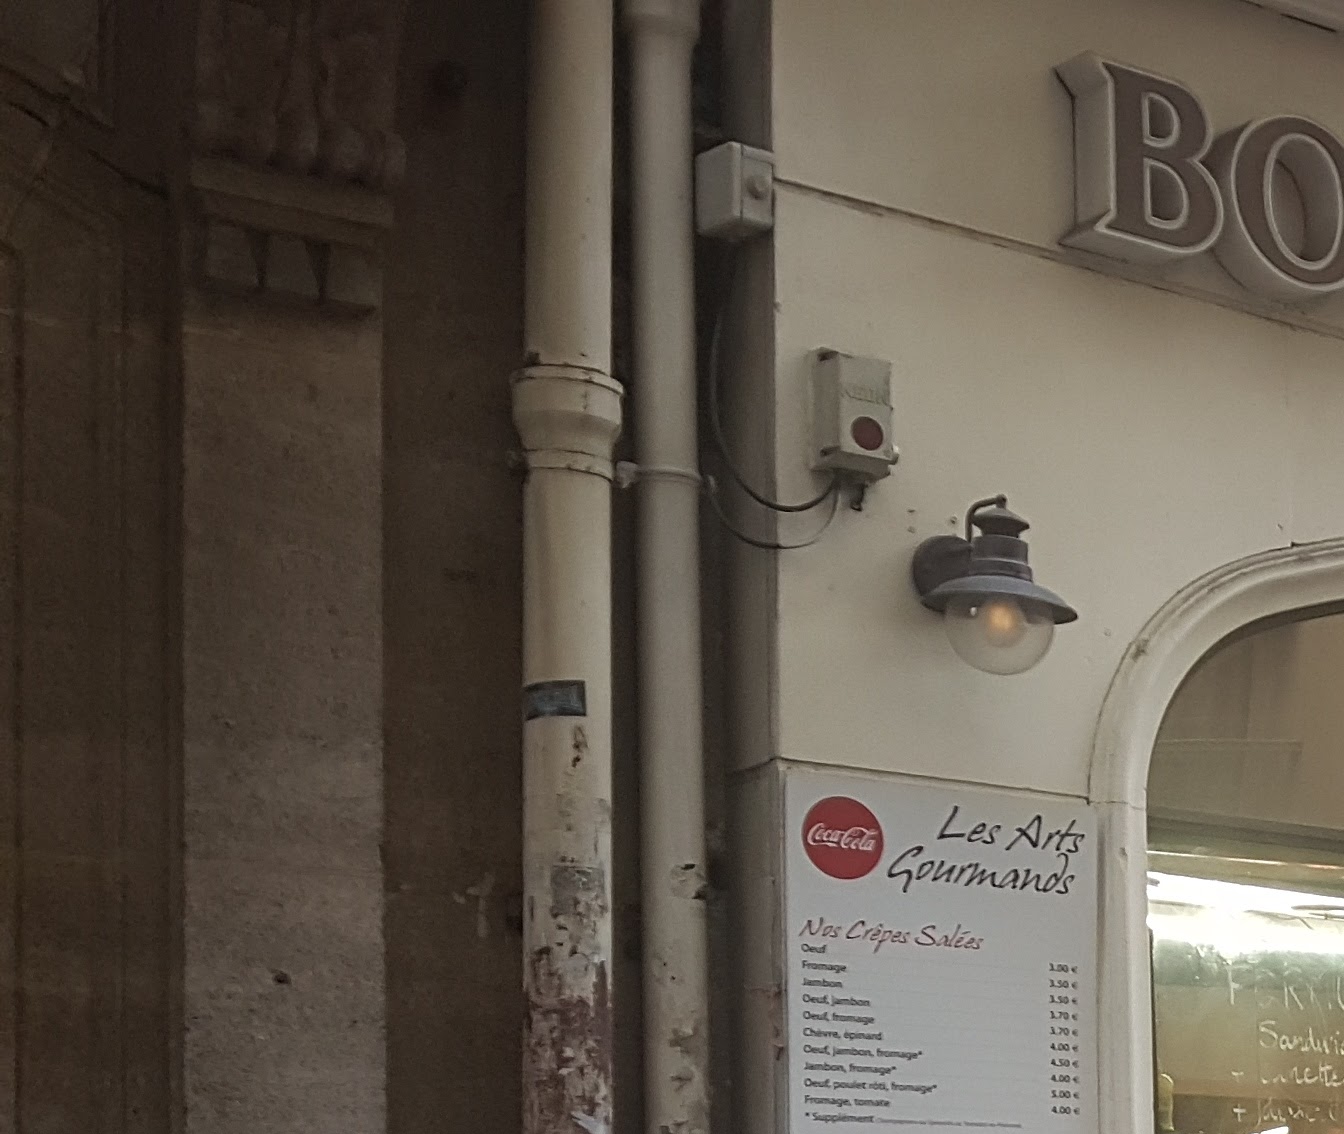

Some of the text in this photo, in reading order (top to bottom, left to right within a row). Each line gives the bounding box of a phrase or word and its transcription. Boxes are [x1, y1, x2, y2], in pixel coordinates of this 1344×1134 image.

[936, 804, 1086, 854] Les Arts
[886, 844, 1076, 894] Gourmands
[799, 916, 986, 954] Nos Crêpes Salées
[800, 942, 828, 954] Oeuf
[801, 960, 847, 974] Fromage
